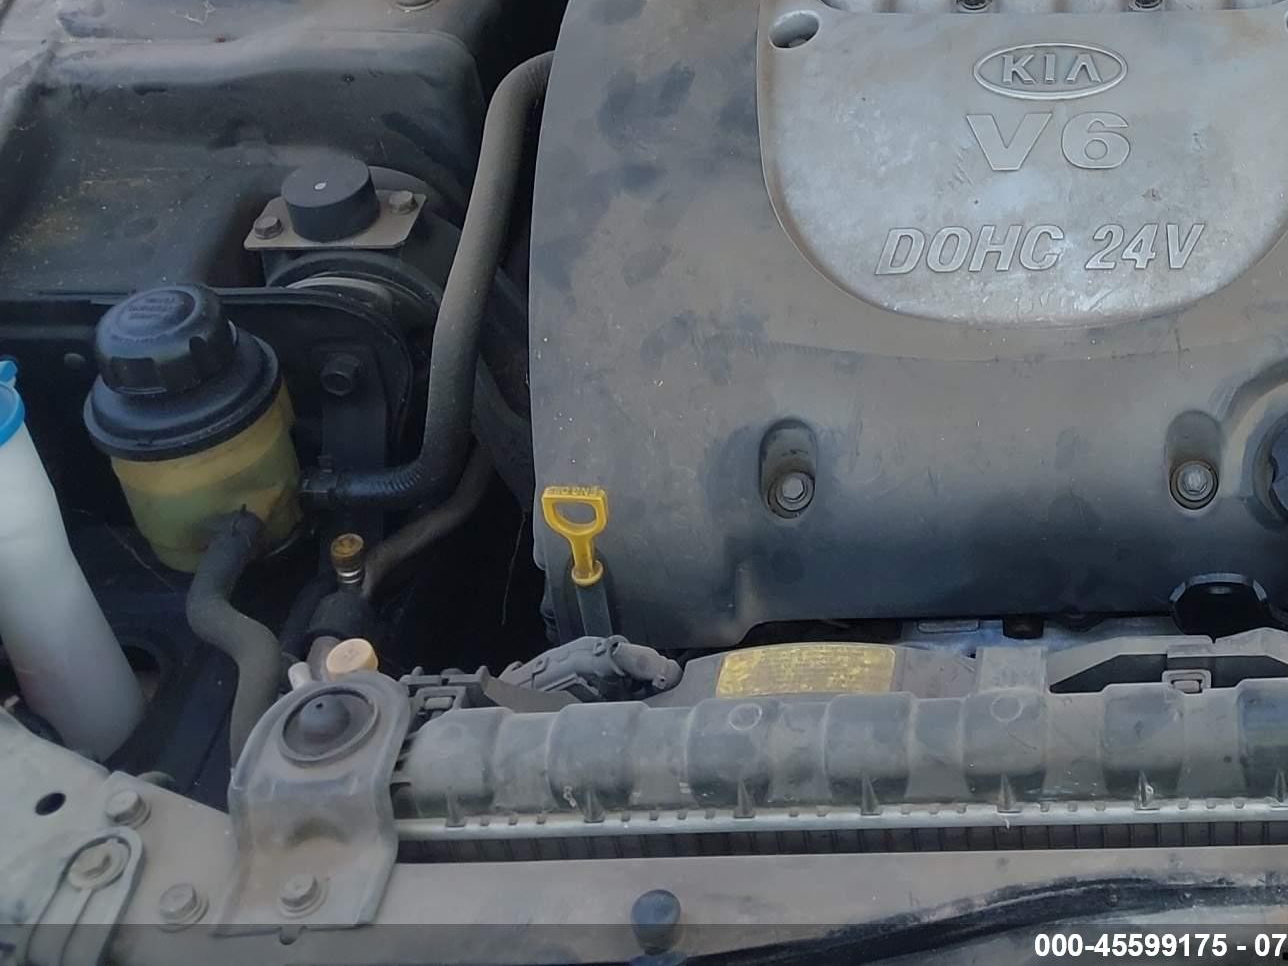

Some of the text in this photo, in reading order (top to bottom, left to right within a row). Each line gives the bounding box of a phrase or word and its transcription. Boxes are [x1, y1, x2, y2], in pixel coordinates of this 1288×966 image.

[1001, 51, 1104, 85] KIA
[966, 109, 1133, 172] V6
[874, 222, 1207, 277] DOHC 24V
